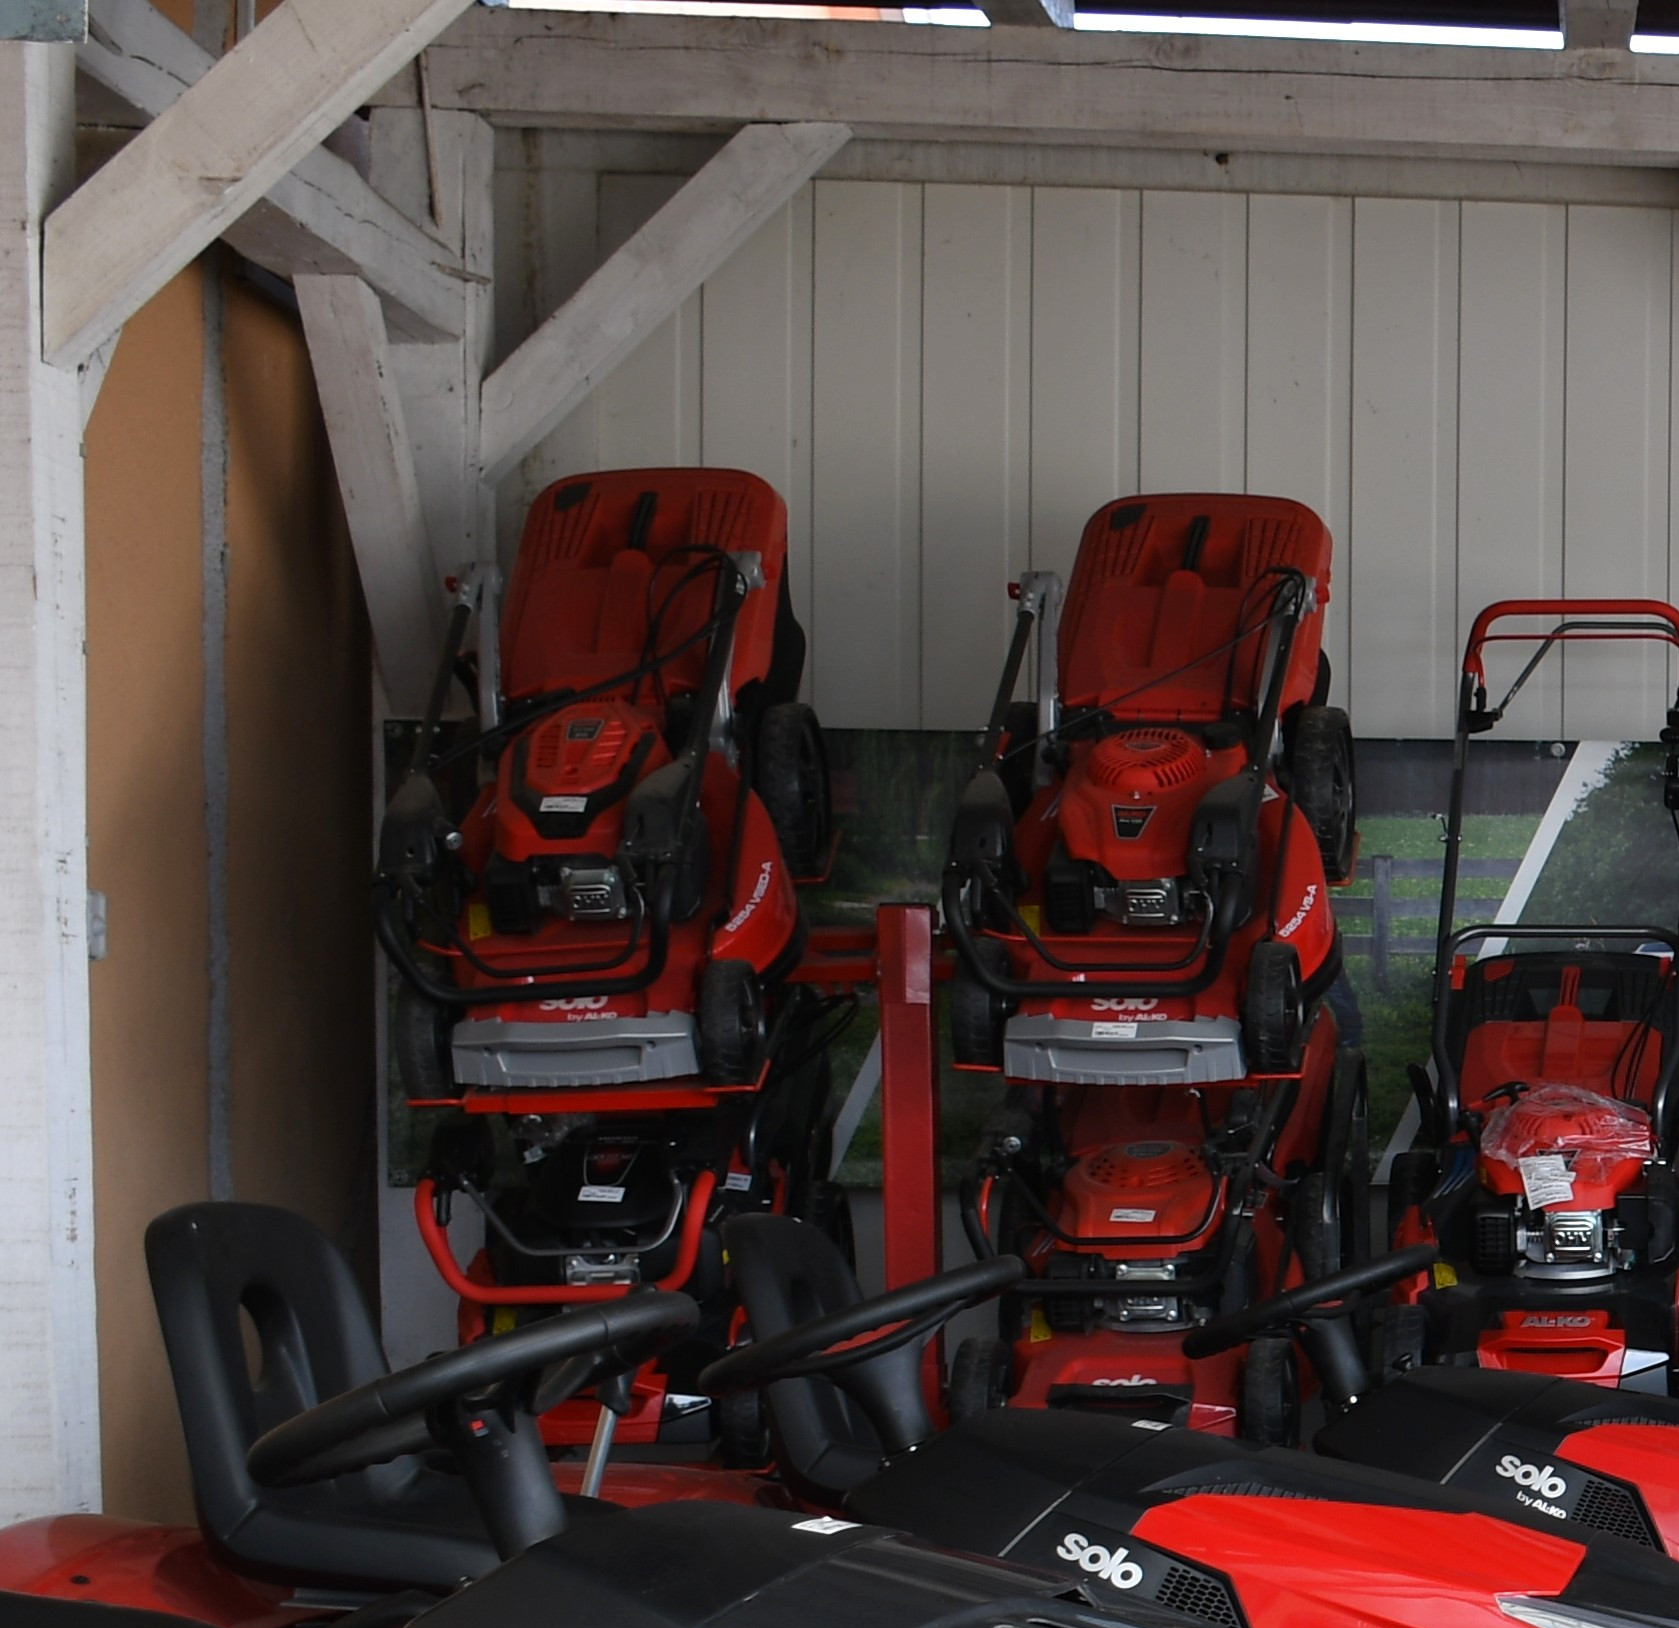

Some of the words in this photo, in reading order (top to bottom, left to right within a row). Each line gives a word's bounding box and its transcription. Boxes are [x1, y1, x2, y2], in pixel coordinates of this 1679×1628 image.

[1495, 1454, 1567, 1499] solo
[1516, 1490, 1532, 1507] by
[1056, 1532, 1144, 1590] solo
